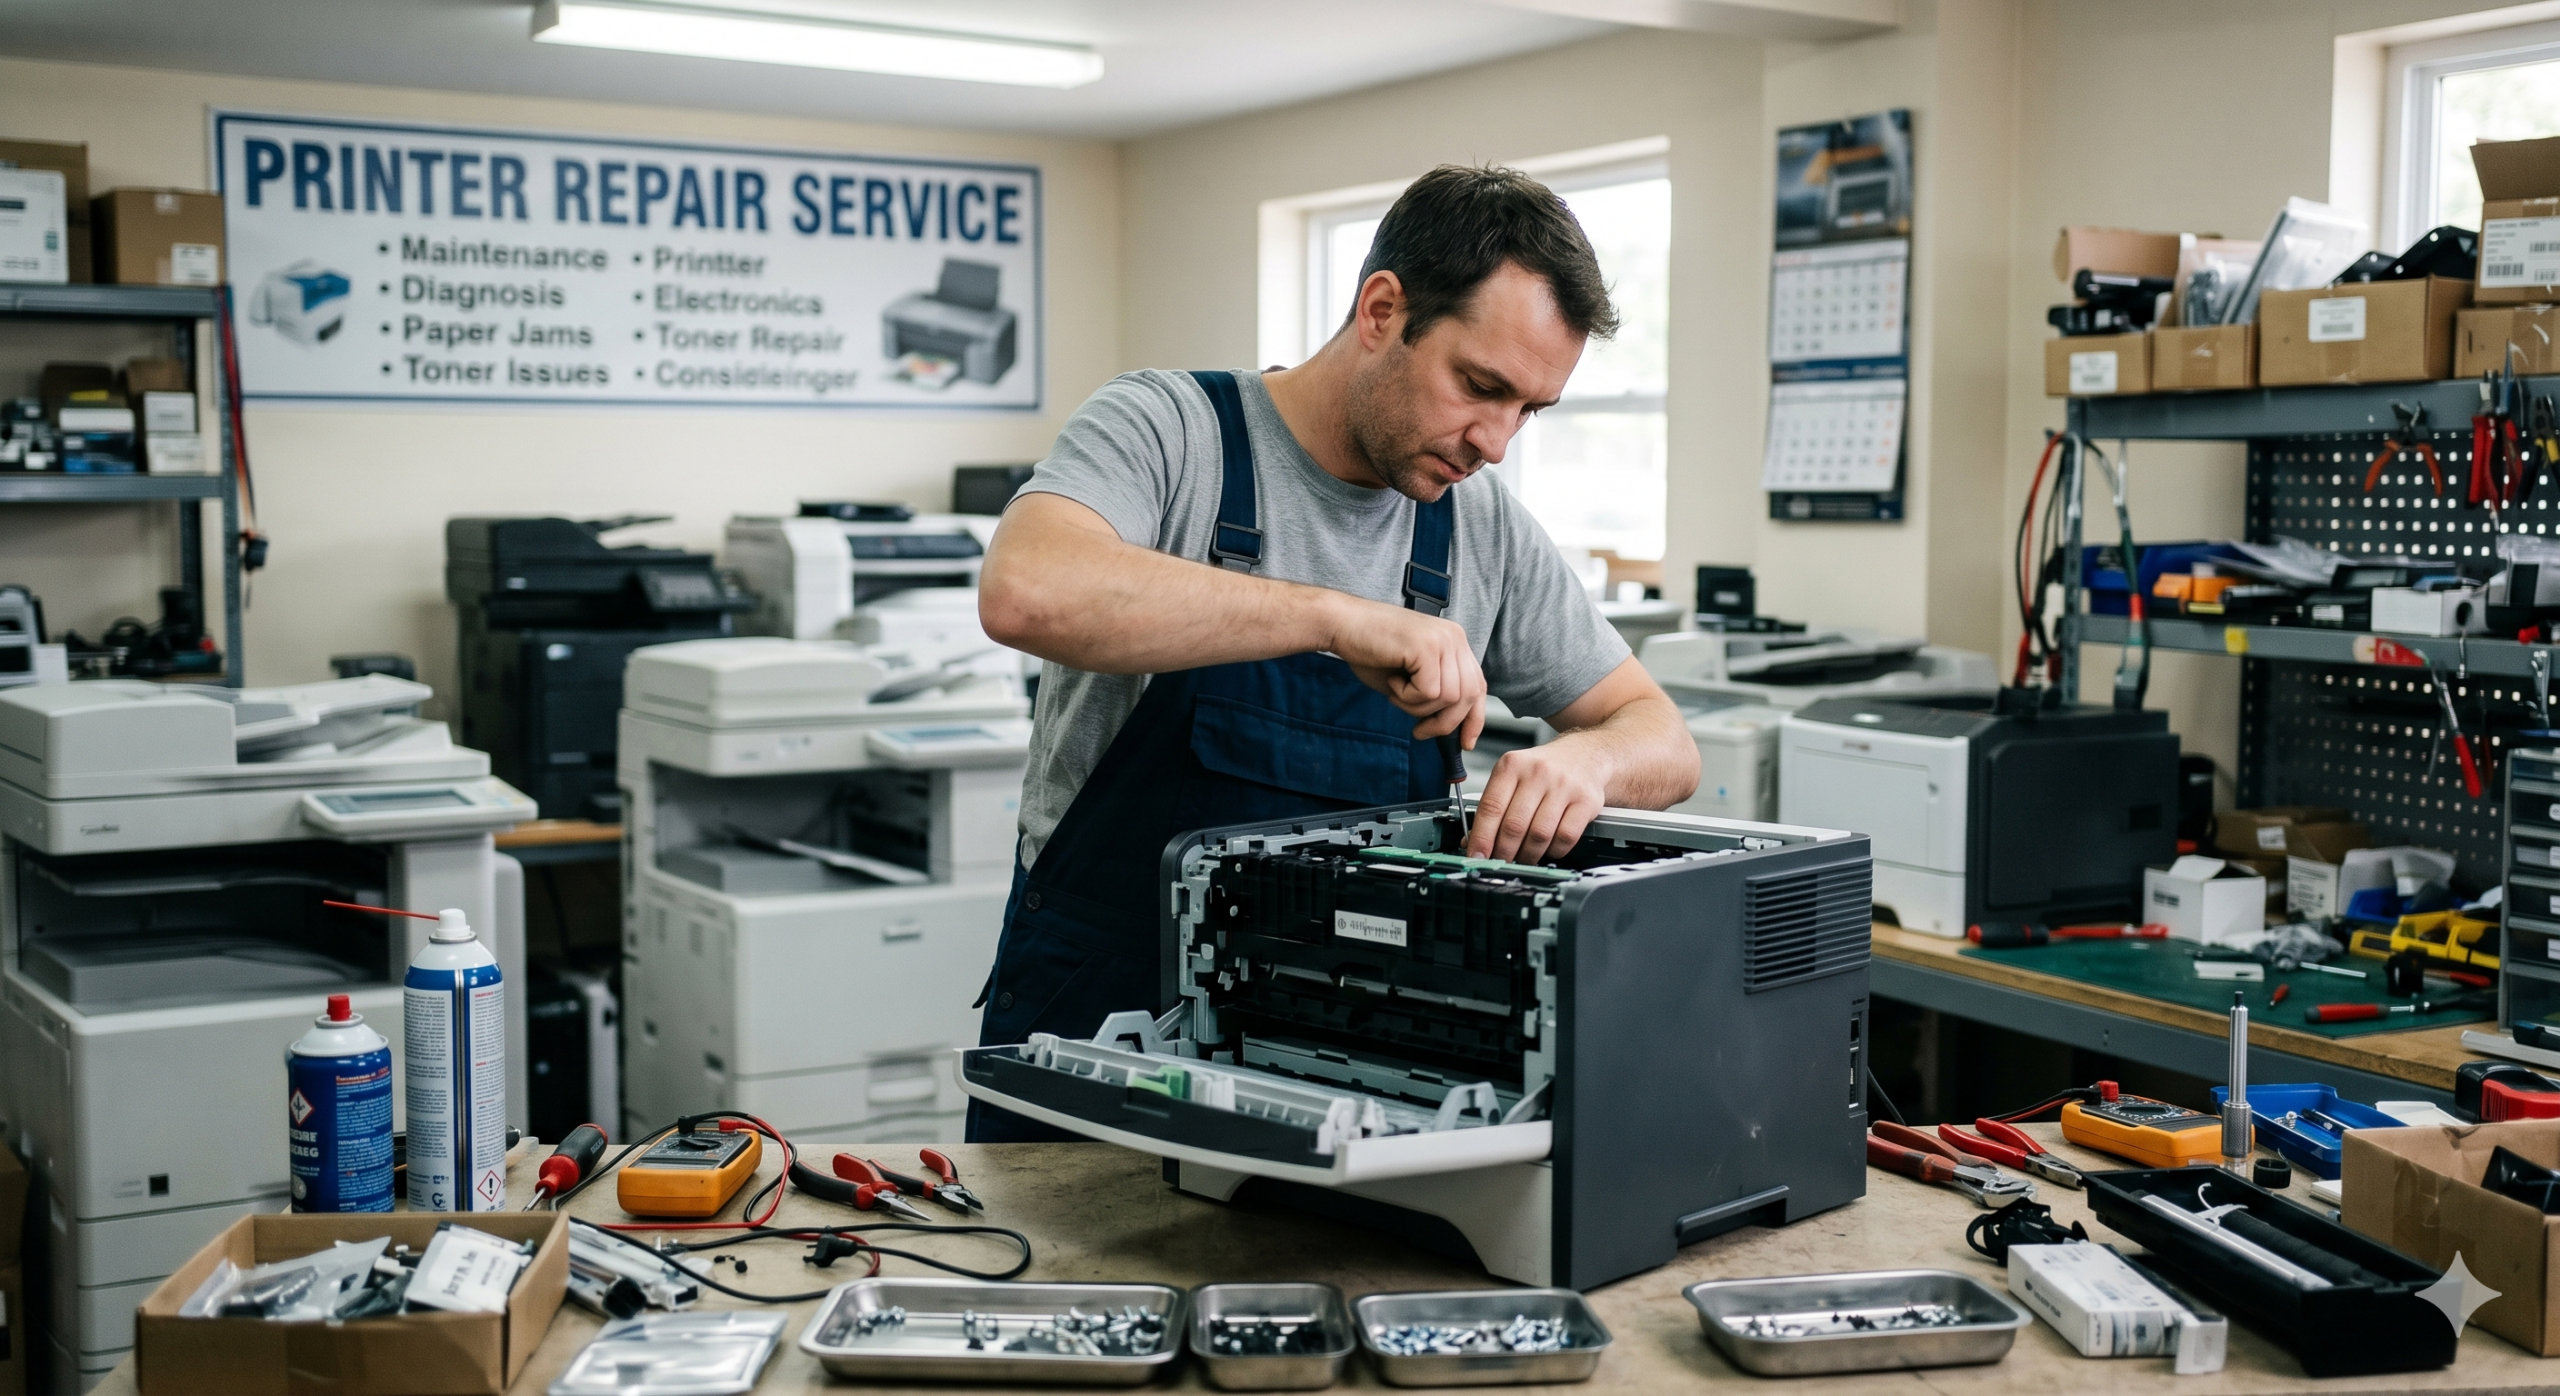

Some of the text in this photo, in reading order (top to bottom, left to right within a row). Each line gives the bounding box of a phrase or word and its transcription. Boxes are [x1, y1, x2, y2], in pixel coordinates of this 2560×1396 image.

[244, 139, 1021, 244] PRINTER REPAIR SERVICE
[401, 236, 609, 268] Maintenance
[403, 275, 566, 310] Diagnosis
[654, 285, 822, 314] Electronics
[404, 316, 593, 350] Paper Jams
[656, 322, 844, 355] Toner Repair
[404, 355, 610, 384] Toner Issues
